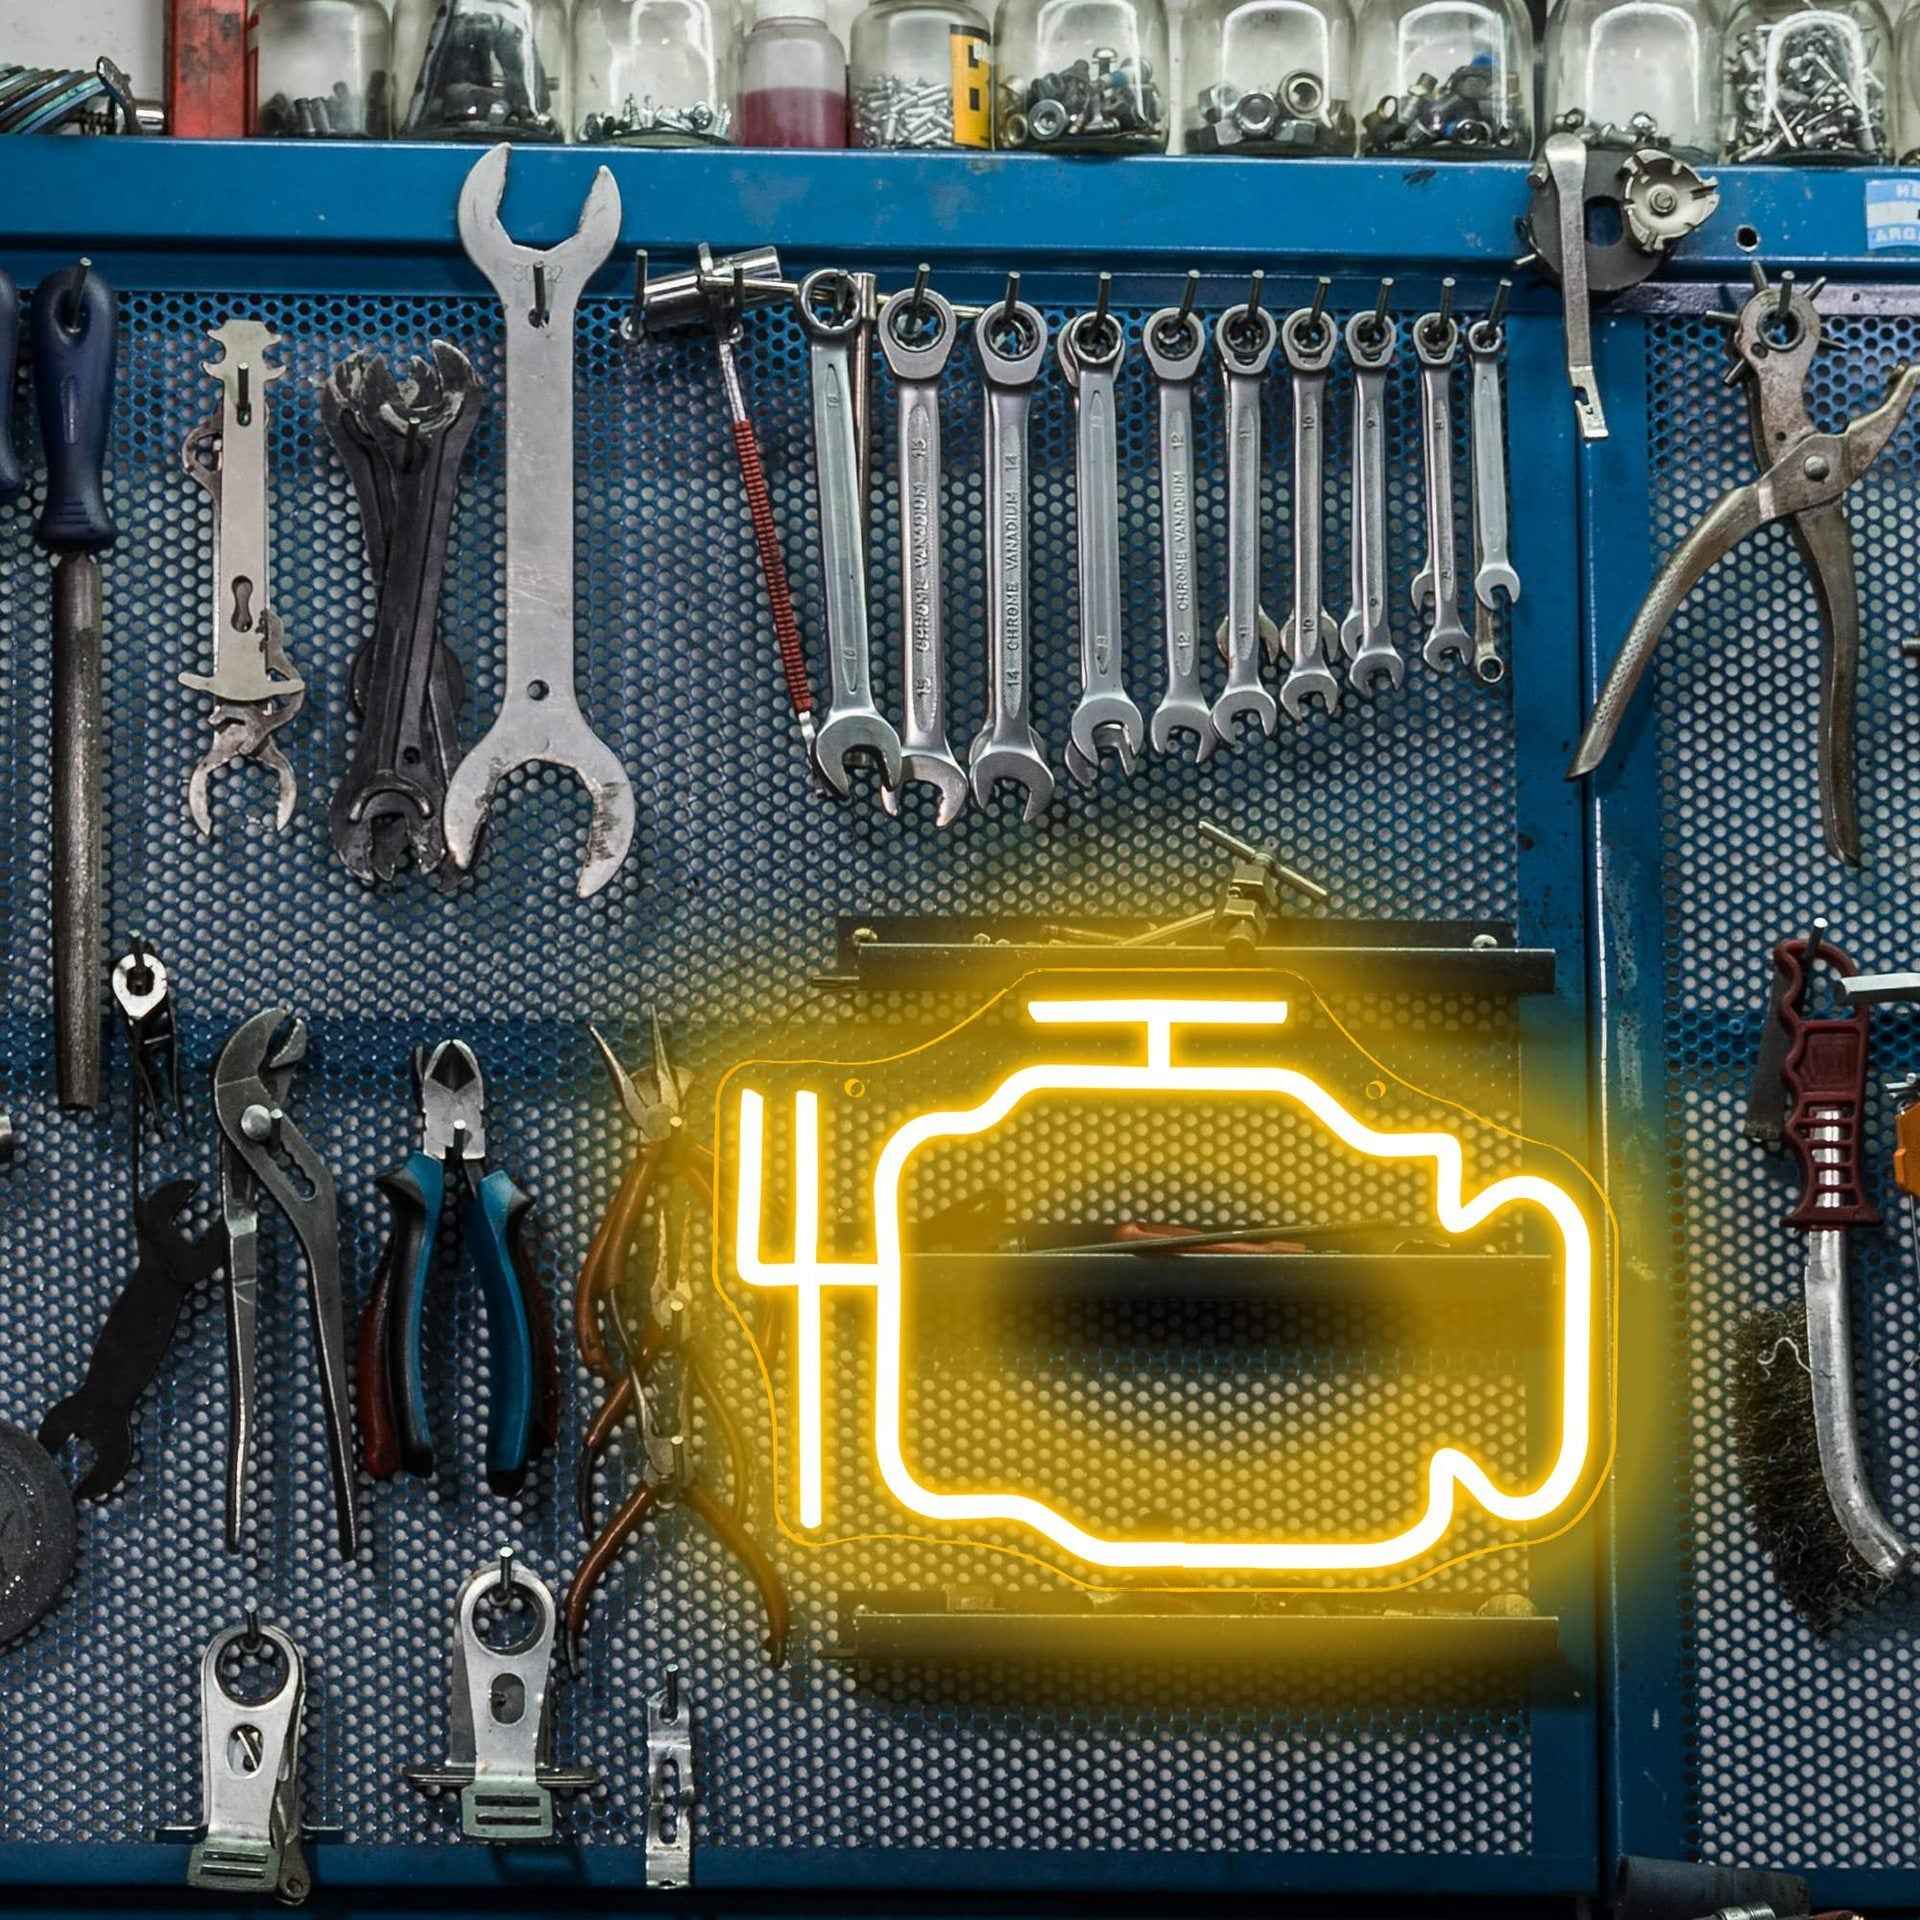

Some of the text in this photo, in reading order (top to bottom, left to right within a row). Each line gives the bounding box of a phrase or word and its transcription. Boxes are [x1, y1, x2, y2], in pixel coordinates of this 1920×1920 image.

[1875, 226, 1920, 242] ARG
[1303, 416, 1315, 431] 10
[911, 479, 929, 569] VANADIUM
[1170, 431, 1192, 650] 12 CHROME VANADIUM 12
[1004, 454, 1021, 688] 14 CHROME VANADIUM 14
[914, 577, 930, 654] CHROME
[1303, 618, 1315, 633] 10
